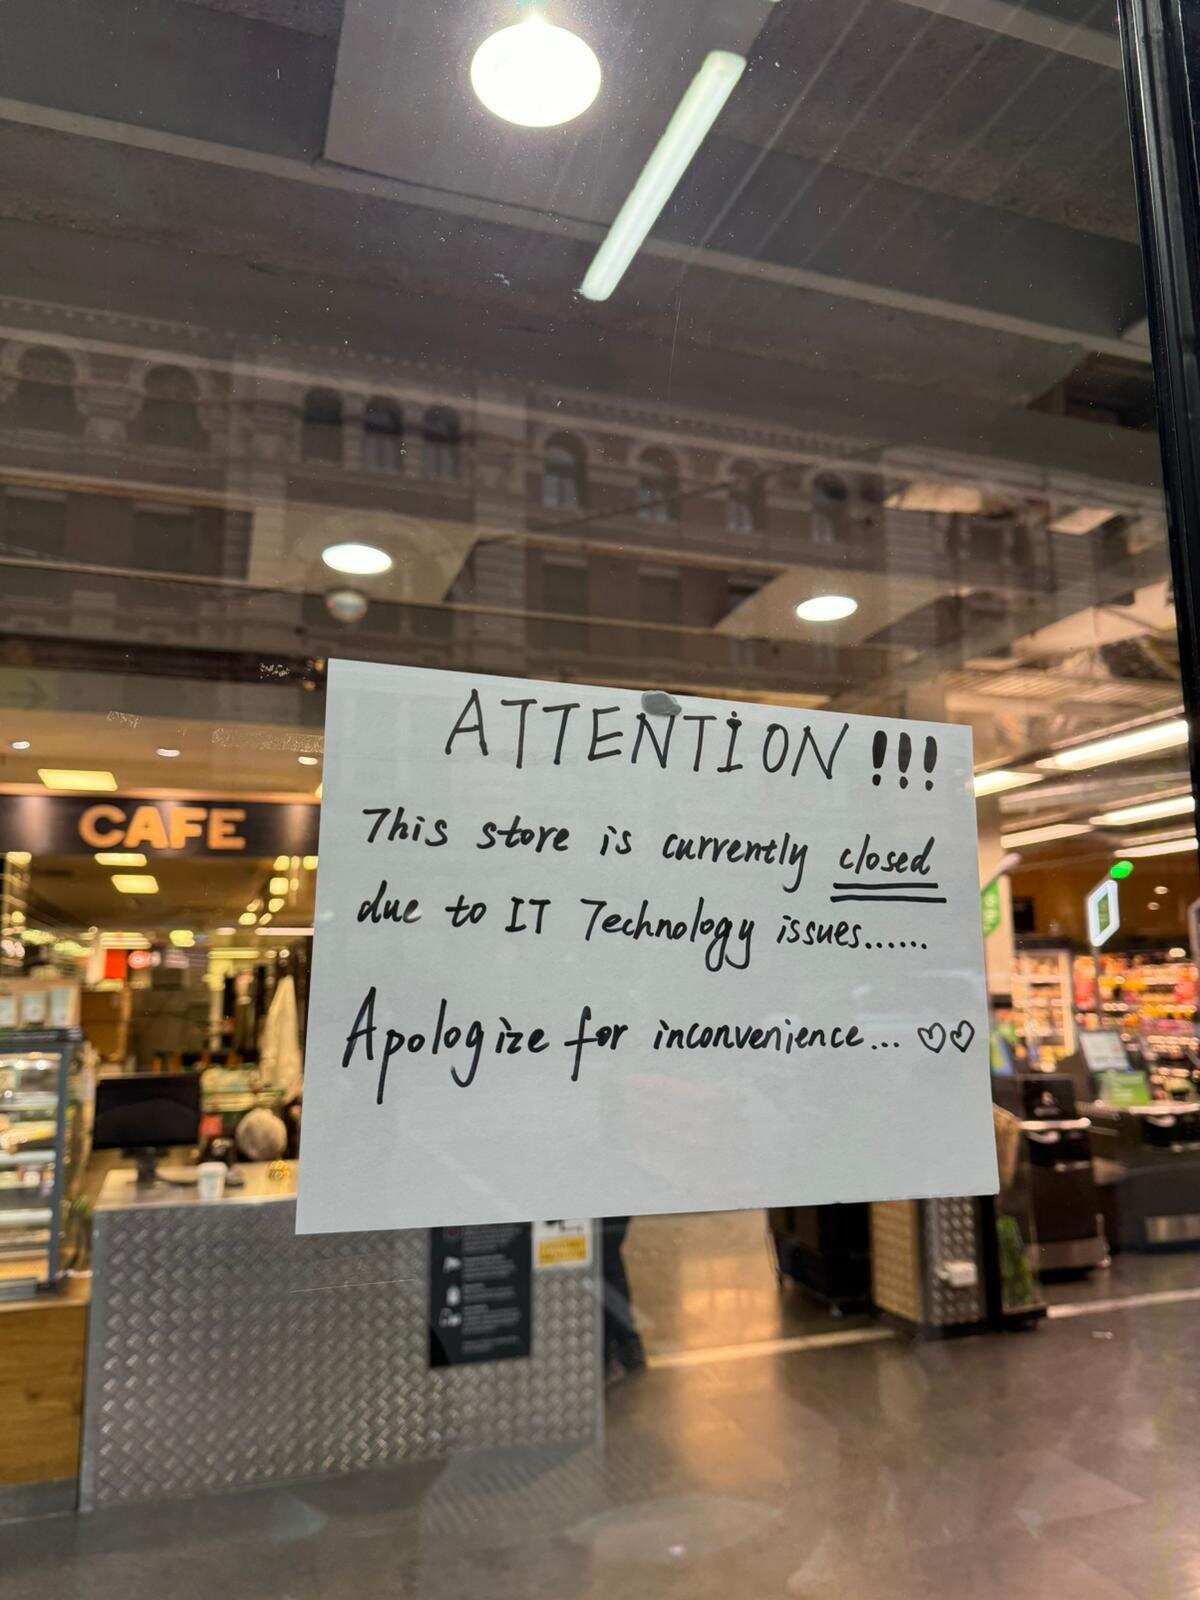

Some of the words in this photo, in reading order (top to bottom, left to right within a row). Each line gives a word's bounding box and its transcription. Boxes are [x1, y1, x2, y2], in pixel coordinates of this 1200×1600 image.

[444, 688, 850, 780] ATTENTION
[871, 730, 938, 792] !!!
[79, 803, 247, 850] CAFE
[362, 806, 448, 847] This
[476, 814, 570, 854] store
[599, 825, 632, 857] is
[662, 832, 809, 894] currently
[839, 836, 935, 876] closed
[356, 879, 422, 924] due
[444, 894, 487, 928] to
[504, 896, 552, 935] IT
[579, 896, 755, 973] Technology
[341, 986, 550, 1106] Apologize
[563, 1005, 629, 1082] for
[653, 1018, 900, 1055] inconvenience...
